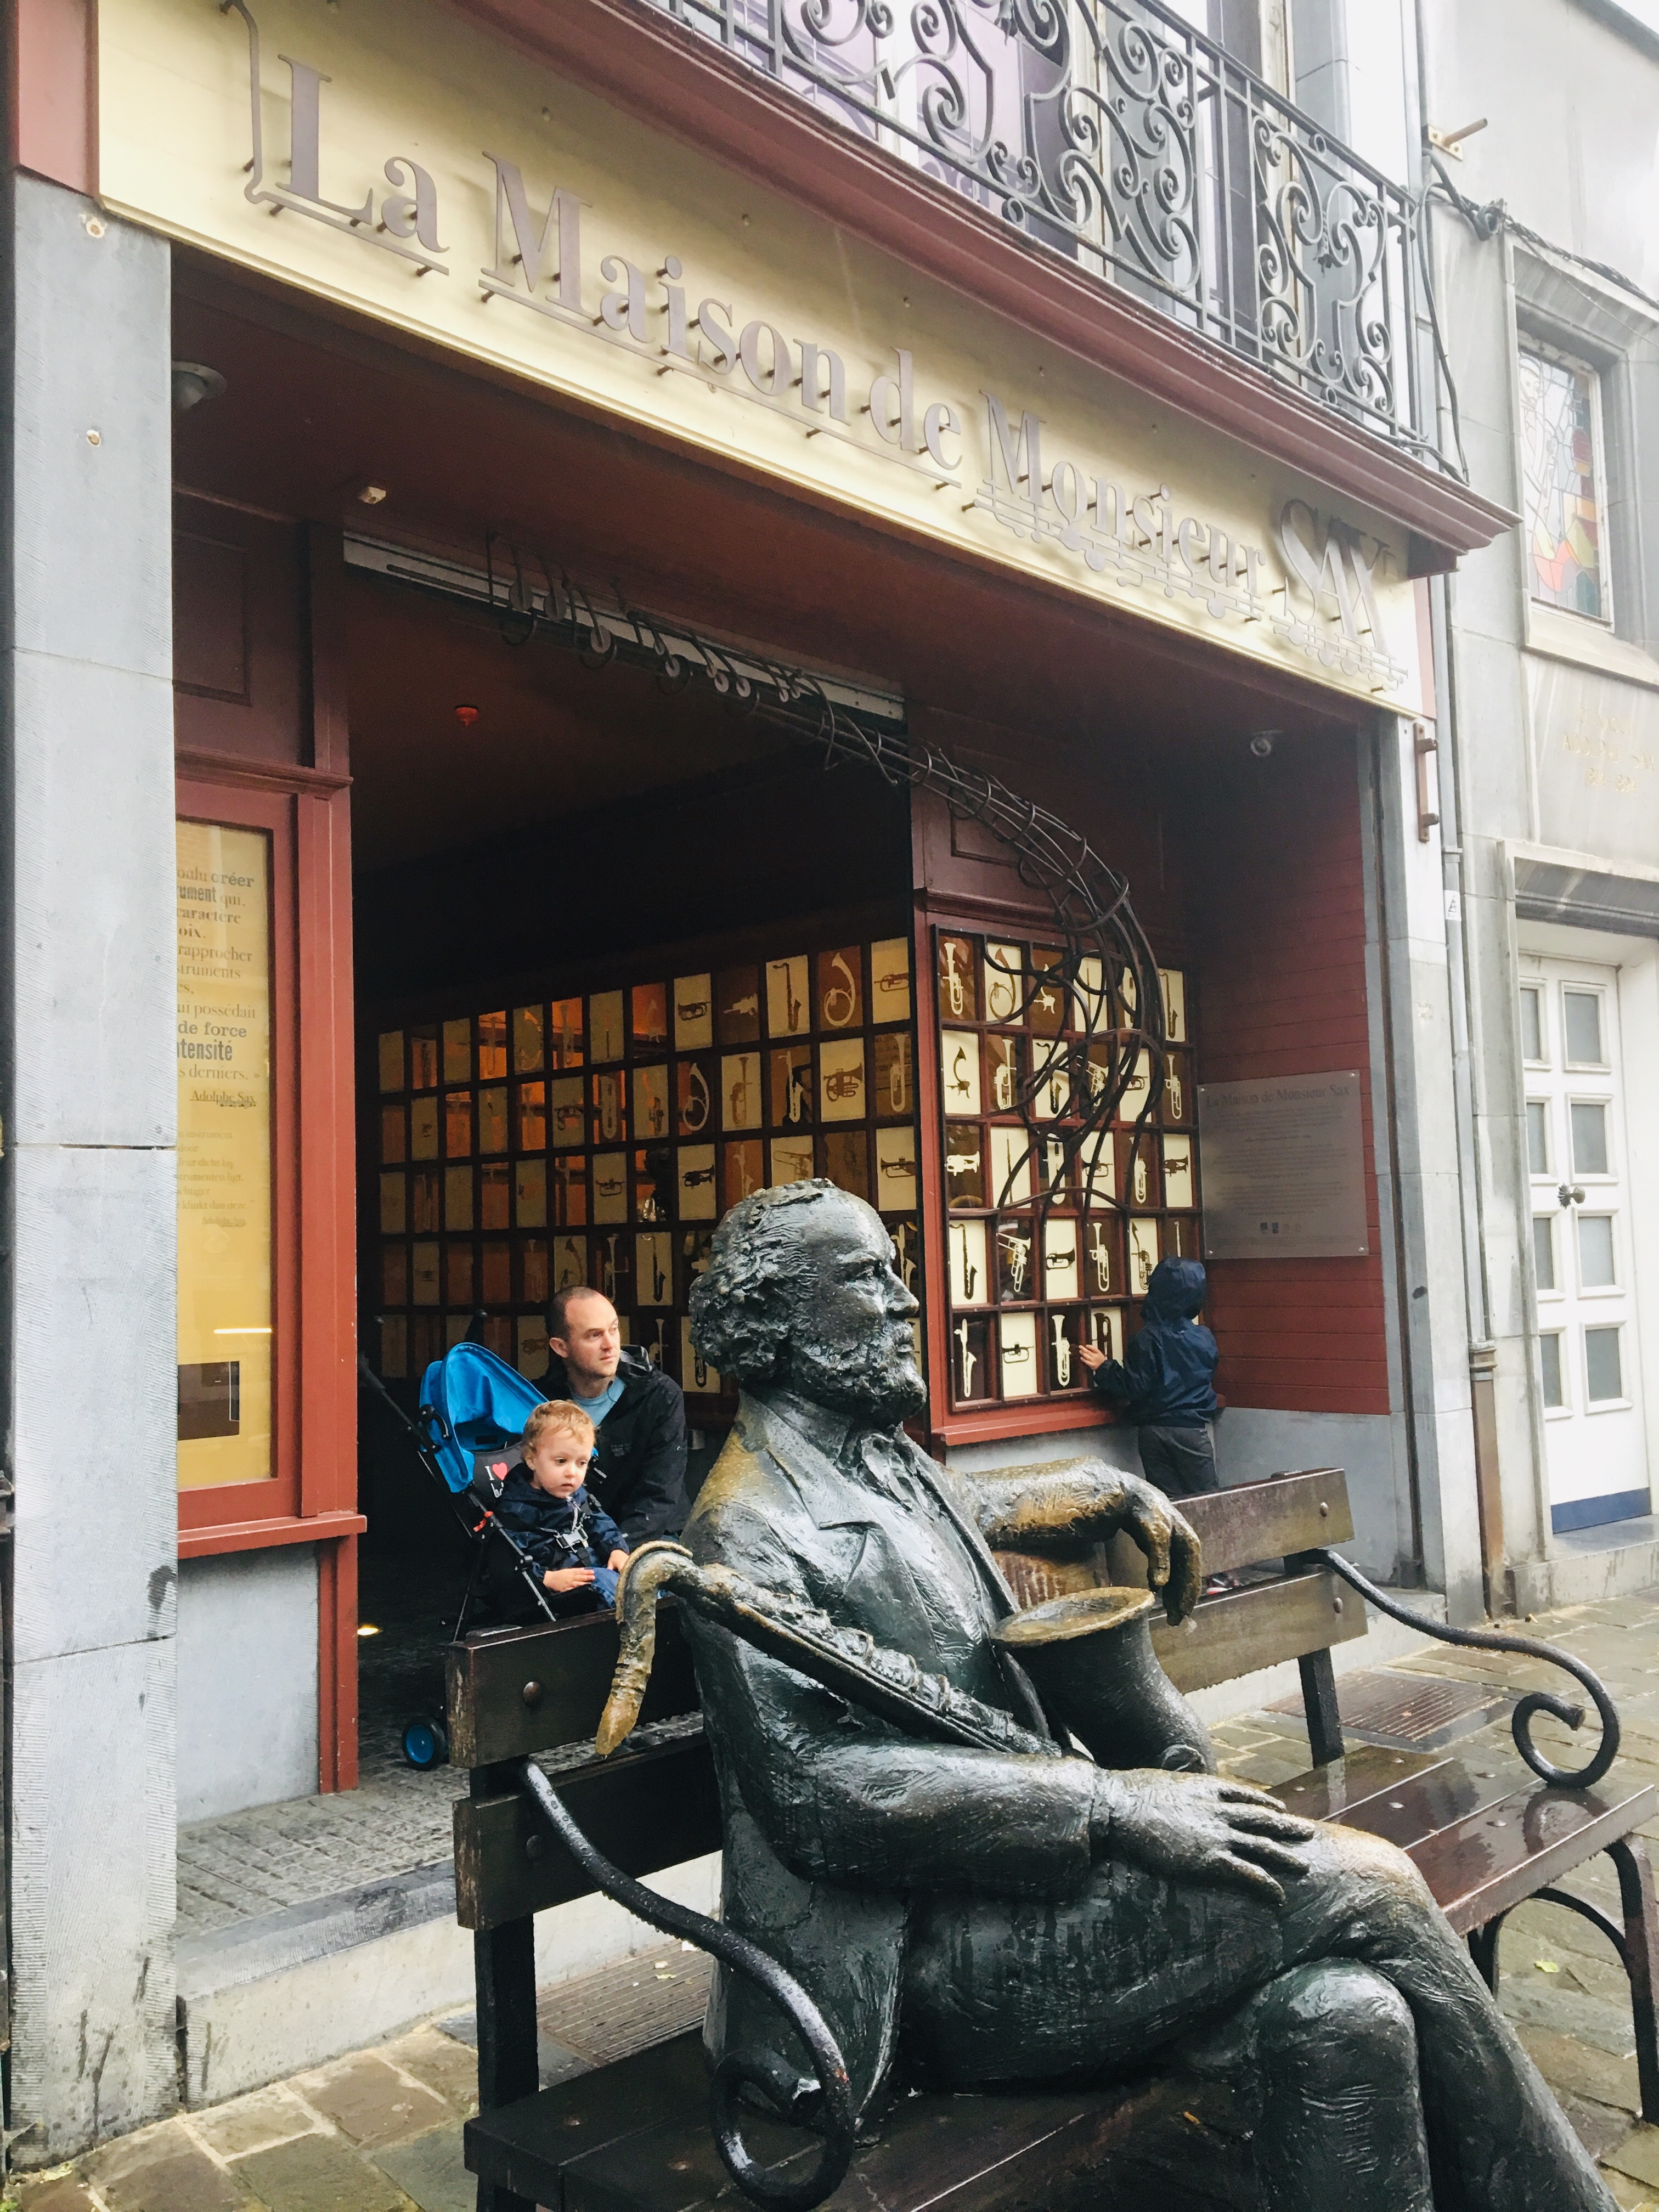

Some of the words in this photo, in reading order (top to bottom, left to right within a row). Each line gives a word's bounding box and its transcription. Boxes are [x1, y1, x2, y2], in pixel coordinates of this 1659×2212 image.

[275, 54, 450, 253] La
[481, 151, 851, 426] Maison
[869, 345, 962, 470] de
[979, 389, 1266, 599] Monsieur
[177, 867, 207, 882] oulu
[211, 871, 254, 887] créer
[178, 945, 253, 962] rapprocher
[177, 1001, 190, 1013] ui
[194, 1003, 257, 1019] possédait
[178, 1020, 198, 1034] de
[204, 1022, 247, 1037] force
[191, 1090, 234, 1104] Adolphe
[238, 1091, 255, 1103] Sax
[1276, 1087, 1326, 1102] Monsieur
[1329, 1084, 1350, 1096] Sax
